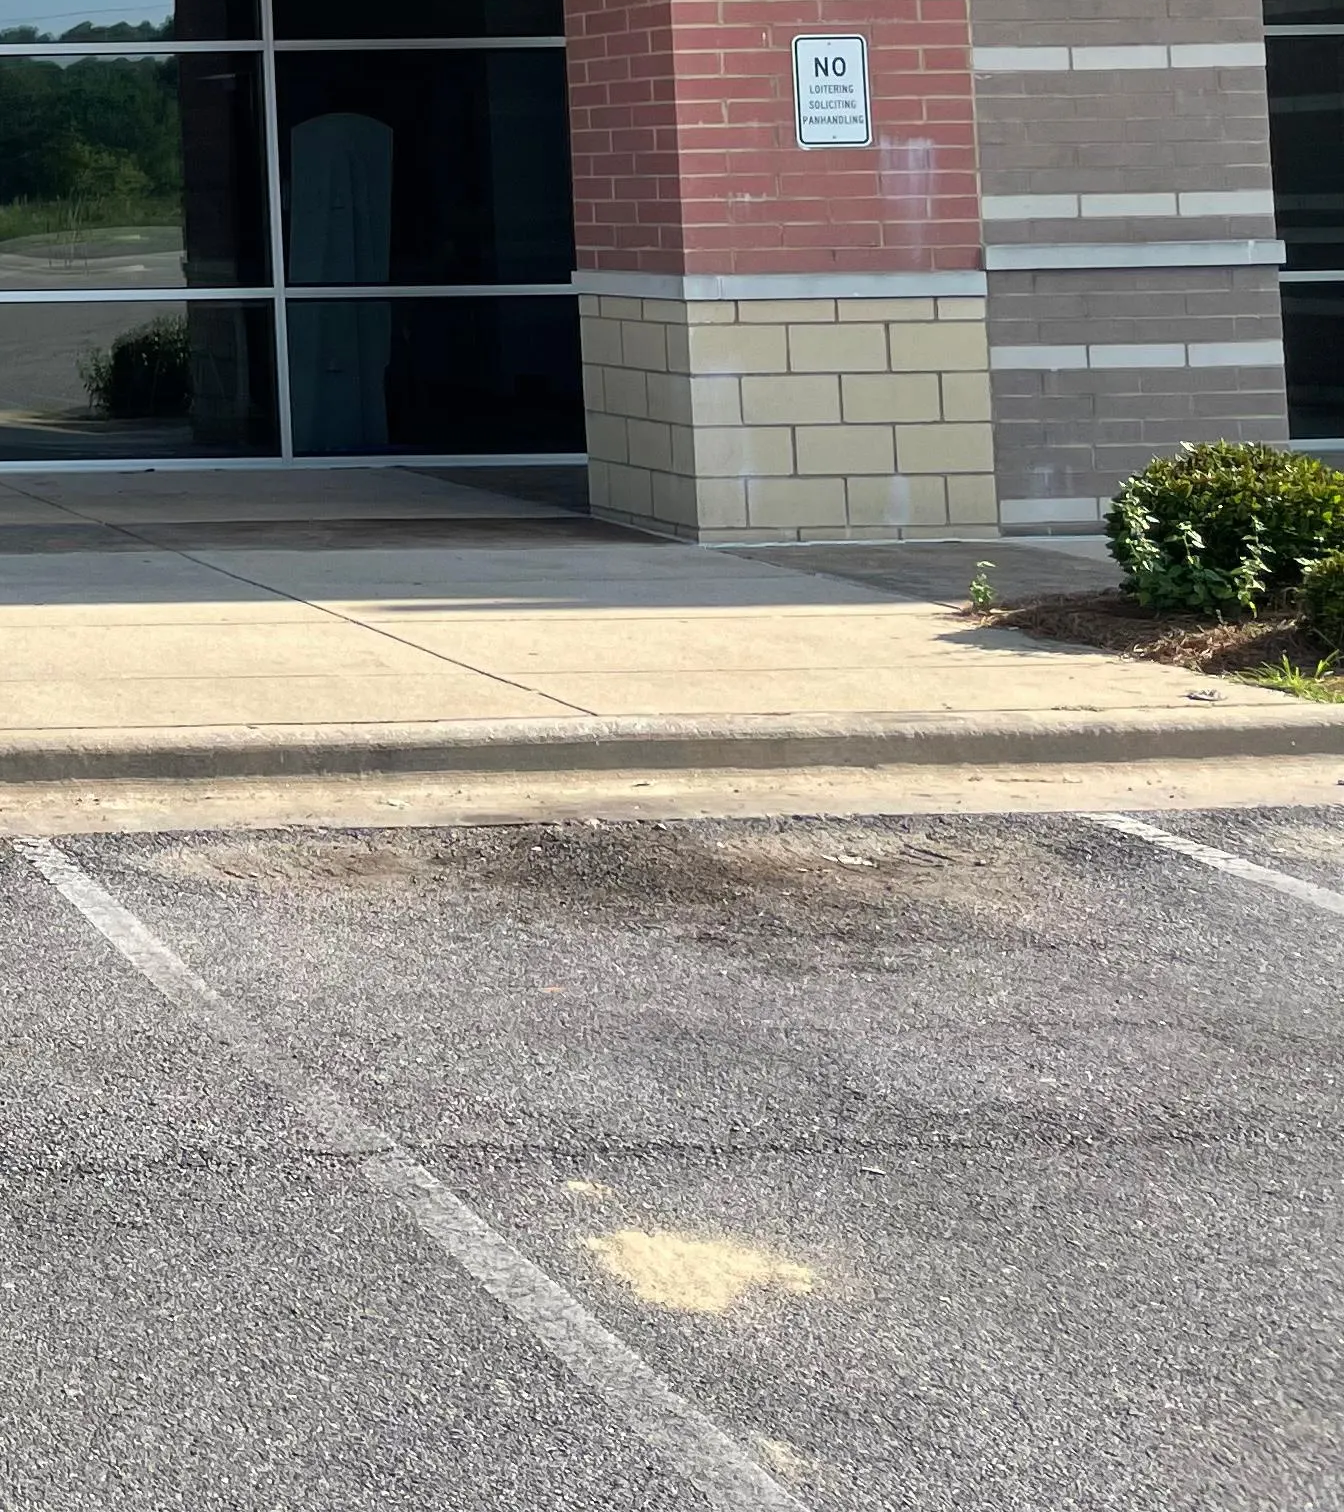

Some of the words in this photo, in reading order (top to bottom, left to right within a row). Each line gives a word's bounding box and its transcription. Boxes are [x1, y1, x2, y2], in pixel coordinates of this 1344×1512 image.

[814, 56, 847, 77] NO
[809, 84, 854, 94] LOITERING
[808, 100, 857, 110] SOLICITING
[802, 115, 865, 125] PANHANDLING
